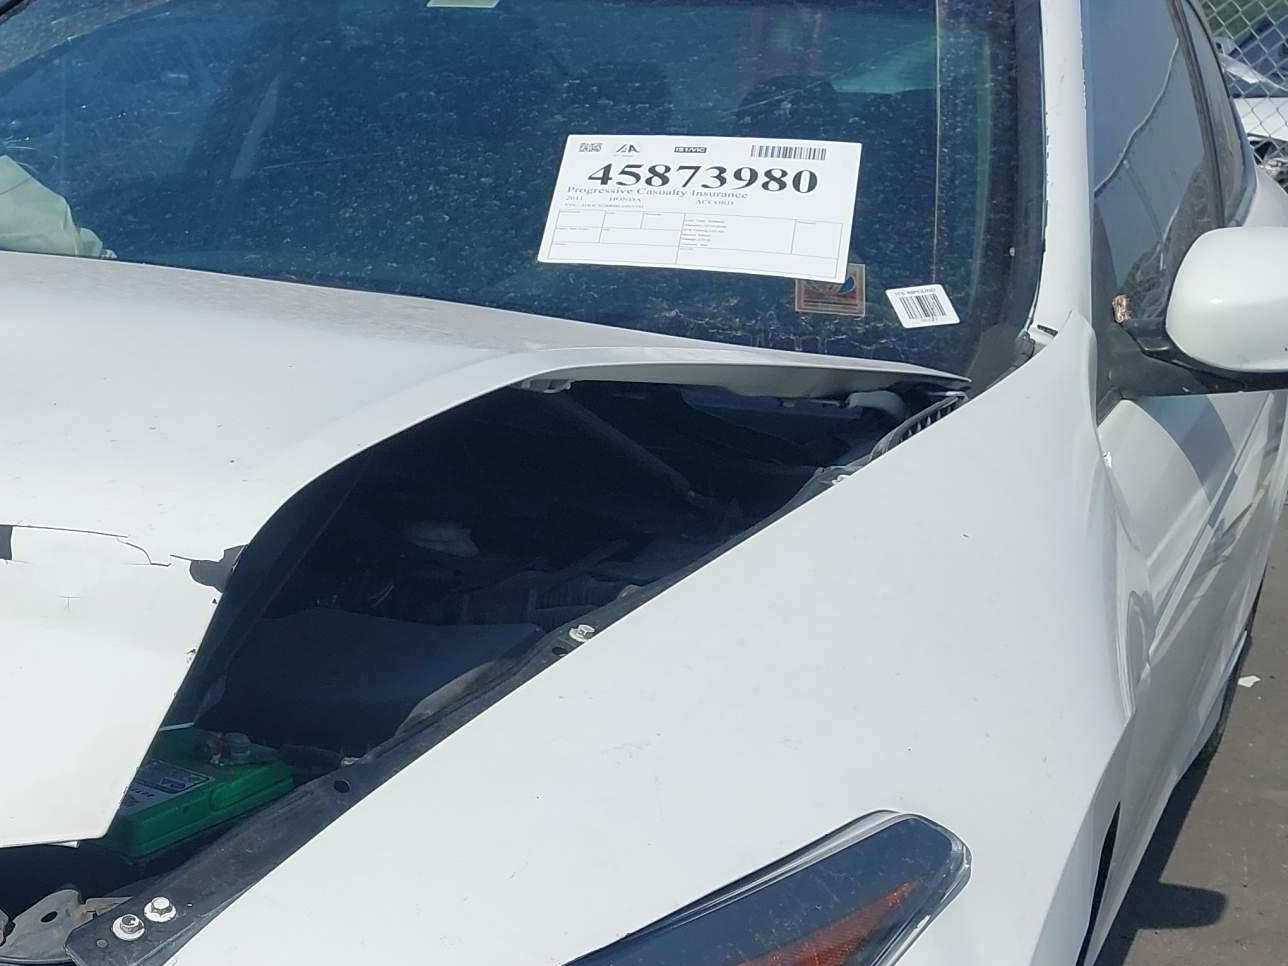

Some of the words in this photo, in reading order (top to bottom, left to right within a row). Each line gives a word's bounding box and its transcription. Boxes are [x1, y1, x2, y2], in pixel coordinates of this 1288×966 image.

[588, 163, 818, 194] 45873980
[567, 186, 633, 196] Progressive
[637, 188, 688, 198] Casualty
[692, 189, 748, 200] Insurance
